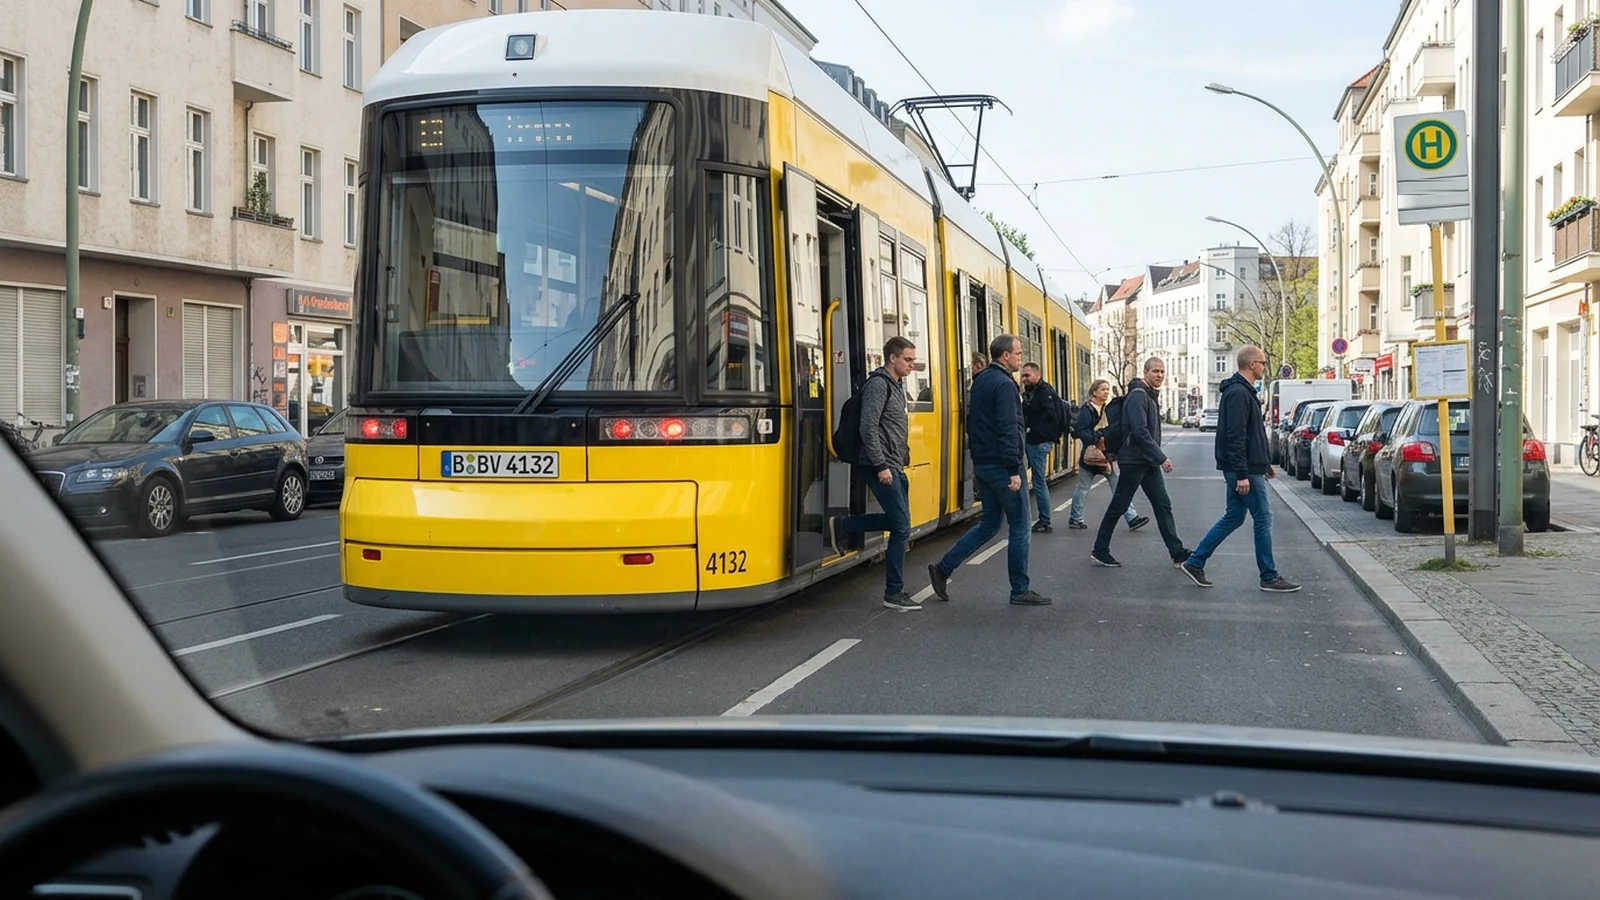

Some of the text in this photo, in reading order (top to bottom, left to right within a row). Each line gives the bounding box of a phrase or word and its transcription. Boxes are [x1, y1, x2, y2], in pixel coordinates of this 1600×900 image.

[1419, 130, 1442, 159] H
[453, 455, 554, 474] B BV 4132
[705, 549, 747, 575] 4132
